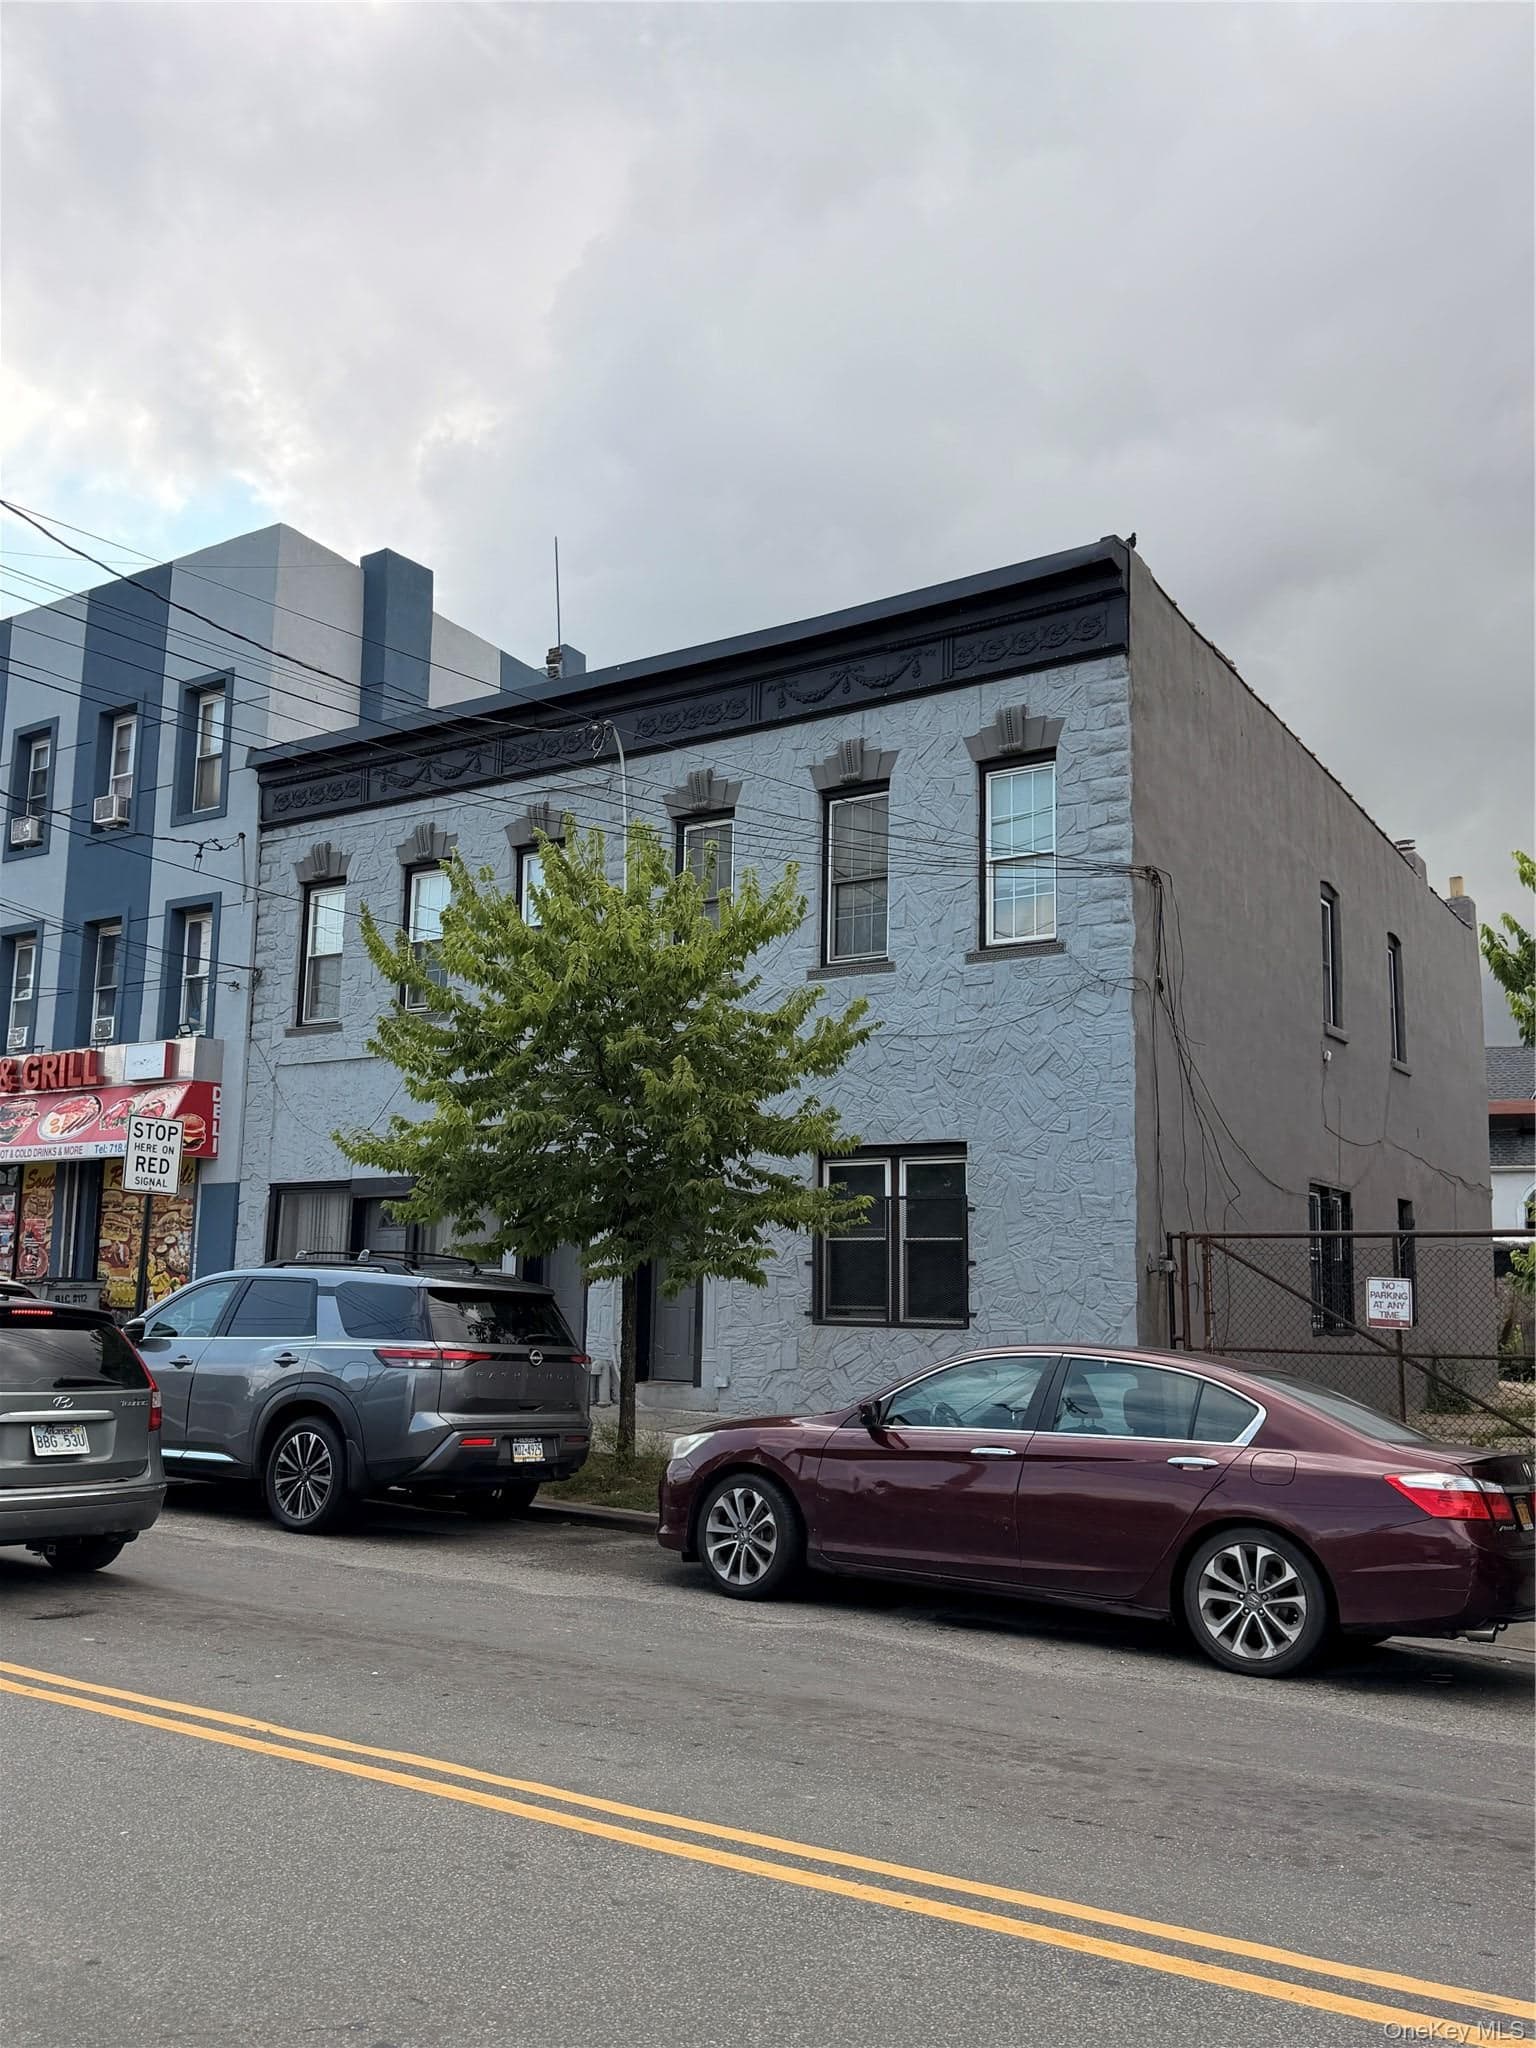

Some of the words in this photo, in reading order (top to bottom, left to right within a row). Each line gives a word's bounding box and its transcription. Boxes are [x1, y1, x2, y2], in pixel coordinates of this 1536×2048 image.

[0, 1058, 14, 1092] &
[22, 1049, 99, 1090] GRILL
[212, 1086, 221, 1153] DELI
[133, 1121, 179, 1142] STOP
[15, 1148, 32, 1158] COLD
[33, 1146, 57, 1157] DRINKS
[64, 1144, 84, 1156] MORE
[94, 1143, 108, 1154] Tel:
[134, 1142, 158, 1153] HERE
[162, 1145, 175, 1155] ON
[135, 1155, 170, 1175] RED
[134, 1176, 168, 1188] SIGNAL
[1381, 1282, 1396, 1290] NO
[1369, 1291, 1409, 1300] PARKING
[1373, 1301, 1384, 1309] AT
[1387, 1301, 1406, 1310] ANY
[1379, 1310, 1401, 1319] TIME
[36, 1435, 58, 1449] BBG
[63, 1433, 86, 1448] 53U
